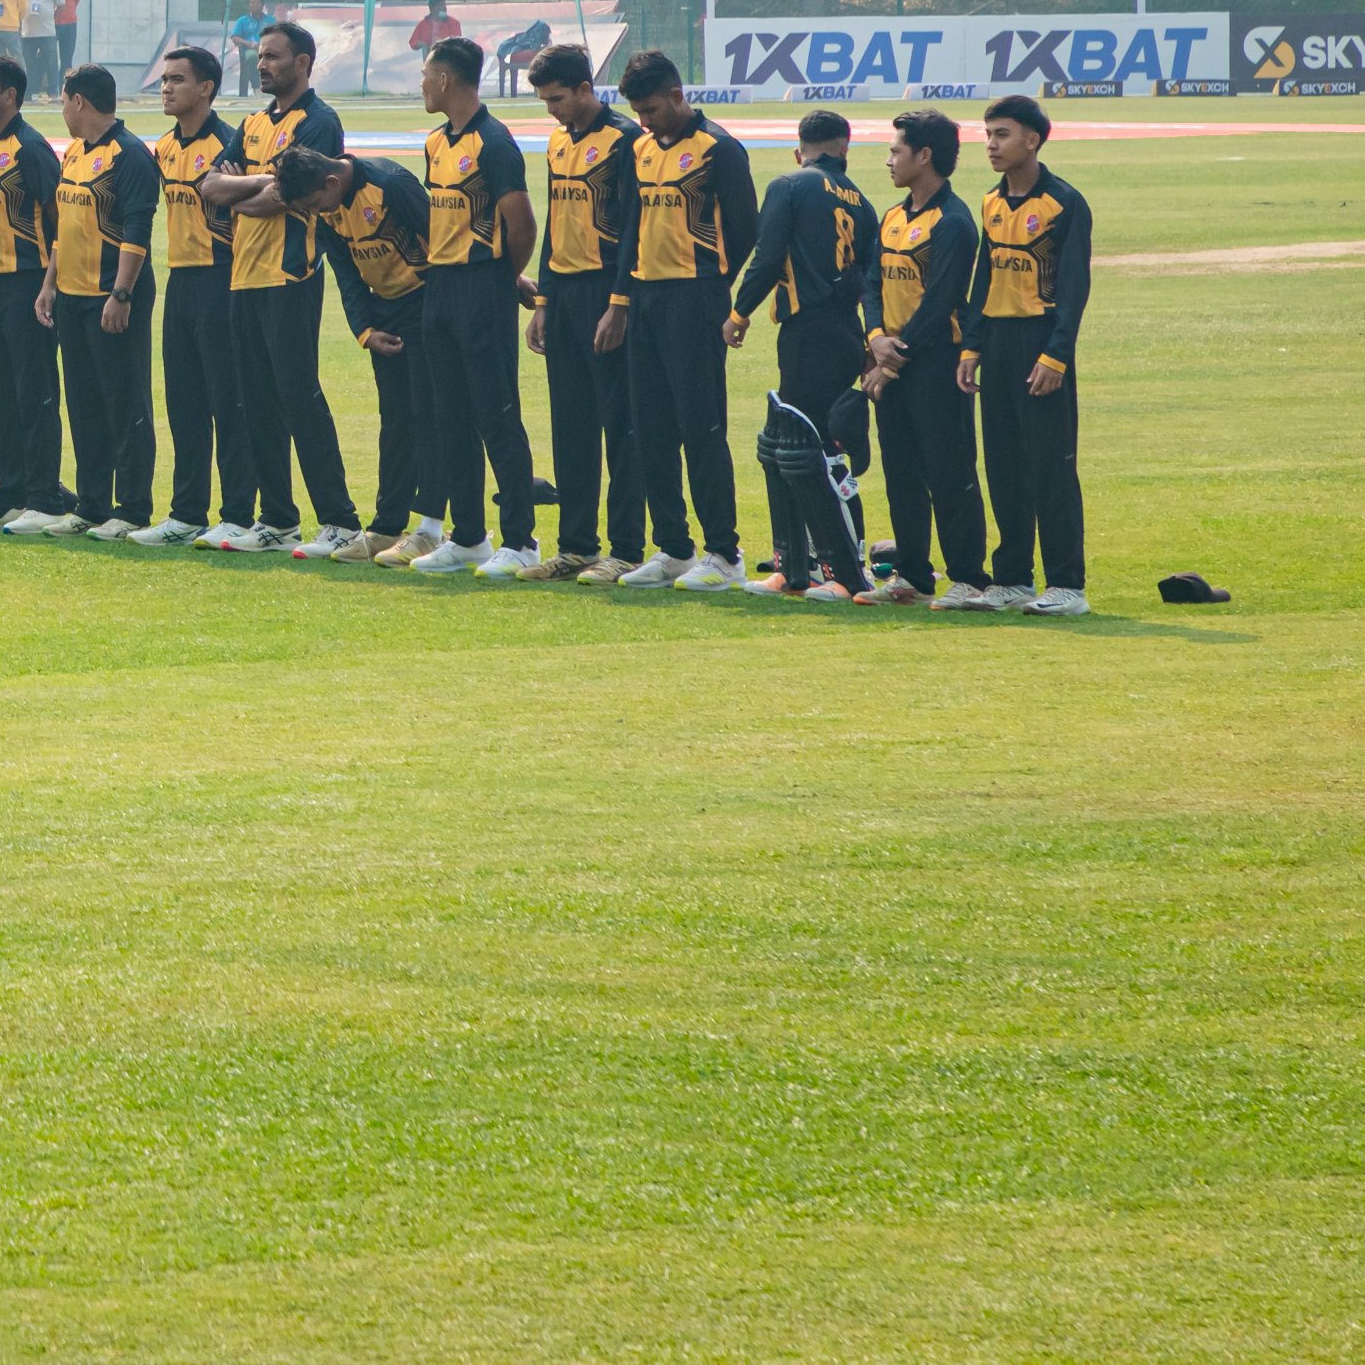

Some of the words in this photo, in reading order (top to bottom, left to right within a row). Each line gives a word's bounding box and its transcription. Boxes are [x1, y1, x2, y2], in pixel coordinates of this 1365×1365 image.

[725, 31, 943, 84] 1XBAT
[986, 27, 1209, 82] 1XBAT
[803, 85, 857, 99] 1XBAT
[921, 84, 976, 98] 1XBAT
[1067, 84, 1115, 95] SKYEXCH
[1181, 81, 1230, 93] SKYEXCH
[1301, 82, 1356, 94] SKYEXCH
[834, 207, 855, 272] 8
